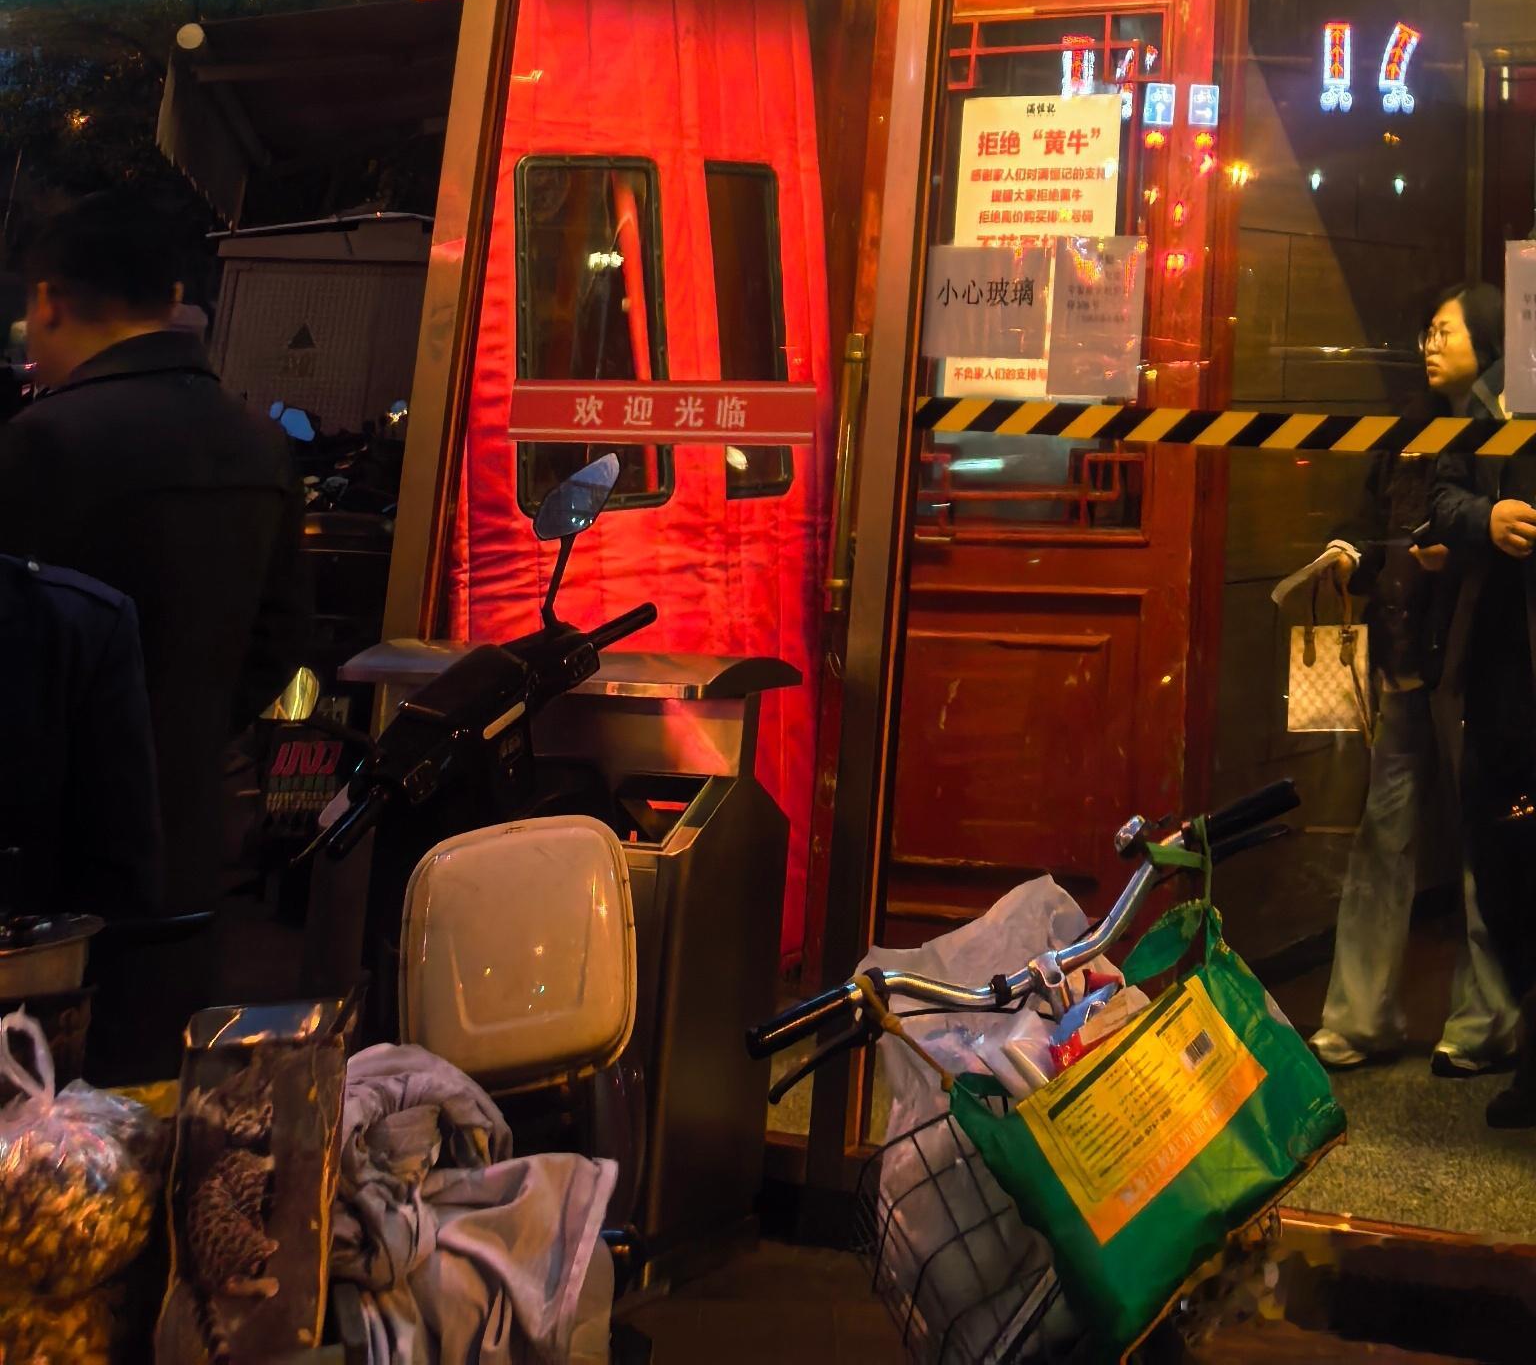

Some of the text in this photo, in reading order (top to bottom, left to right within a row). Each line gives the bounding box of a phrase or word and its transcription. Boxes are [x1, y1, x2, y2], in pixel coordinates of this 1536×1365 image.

[937, 276, 1035, 308] 小心玻璃
[572, 395, 748, 429] 欢迎光临
